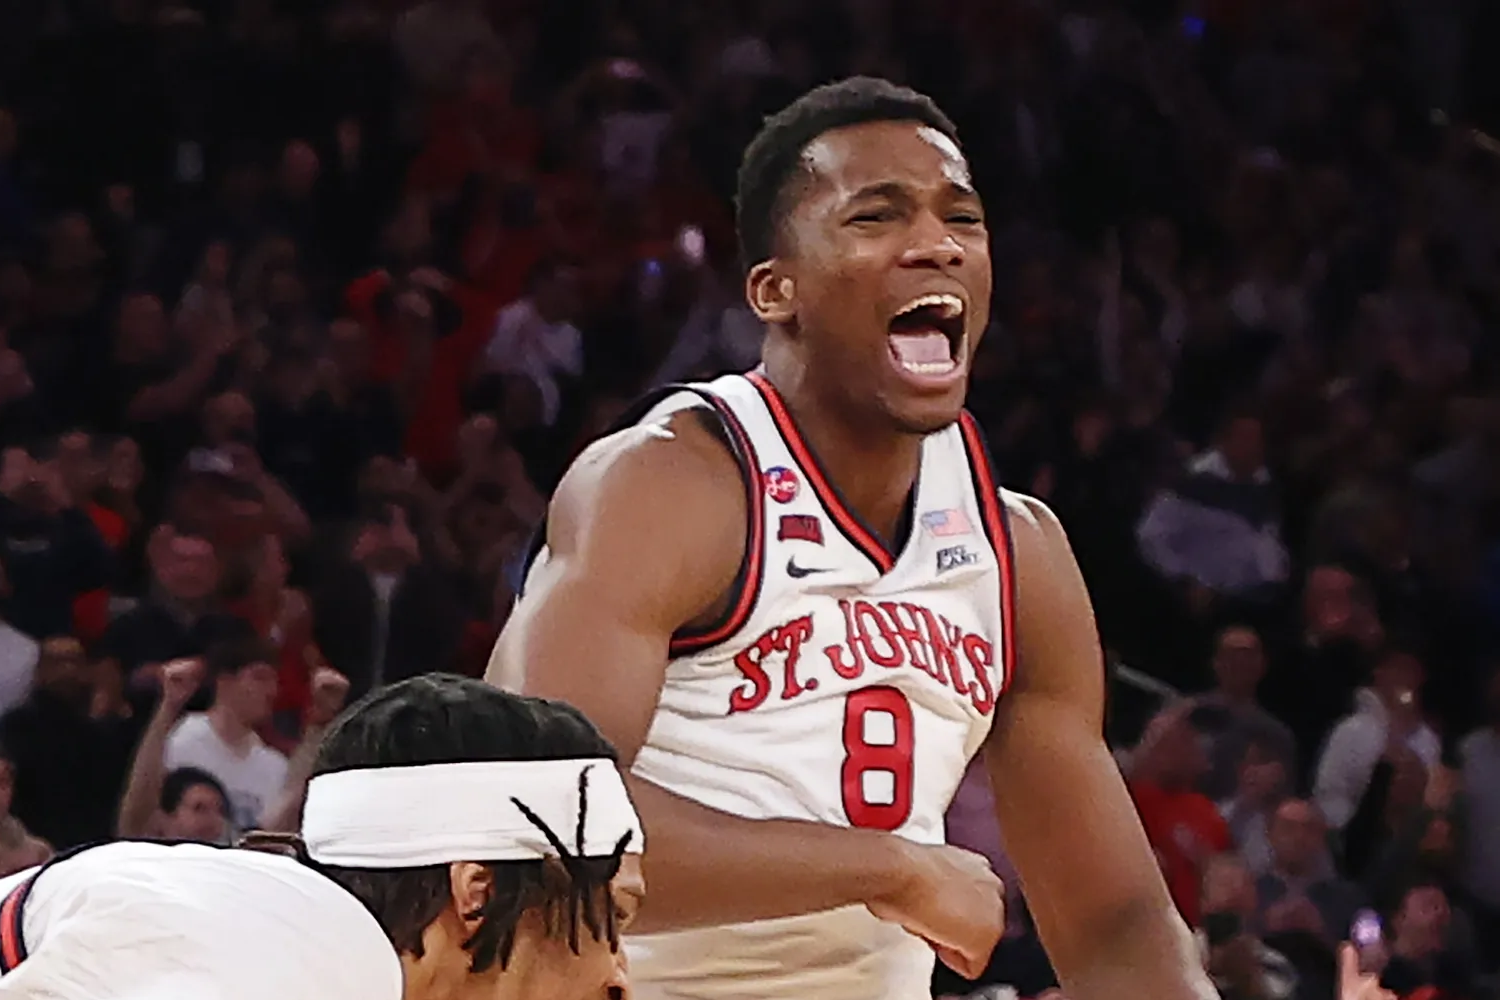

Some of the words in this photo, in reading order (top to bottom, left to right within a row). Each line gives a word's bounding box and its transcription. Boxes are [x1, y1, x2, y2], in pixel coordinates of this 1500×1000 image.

[727, 611, 819, 716] ST.
[823, 599, 994, 716] JOHN'S
[841, 684, 915, 831] 8
